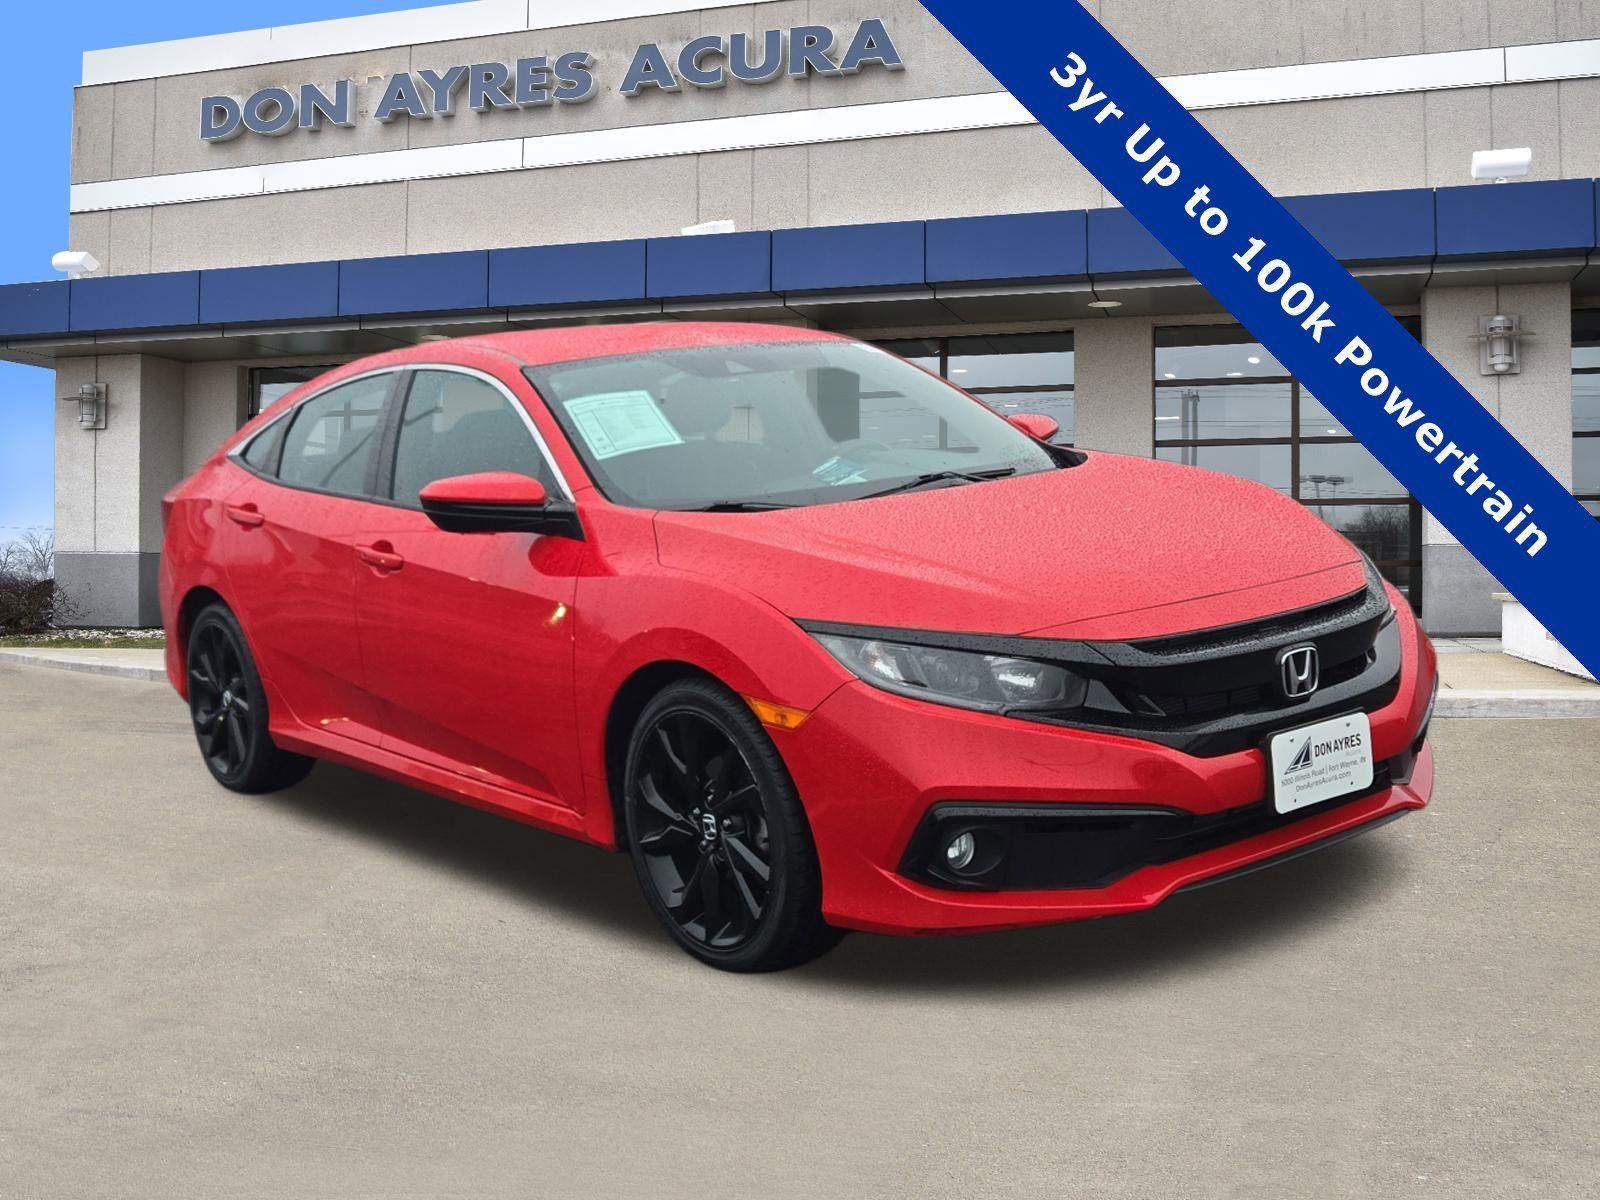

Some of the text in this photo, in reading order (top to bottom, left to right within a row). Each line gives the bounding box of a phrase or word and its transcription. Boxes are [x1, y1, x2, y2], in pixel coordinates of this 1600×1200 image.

[200, 18, 905, 143] DON AYRES ACURA
[1314, 742, 1332, 757] DON
[1333, 733, 1361, 753] AYRES
[1311, 767, 1325, 778] Road
